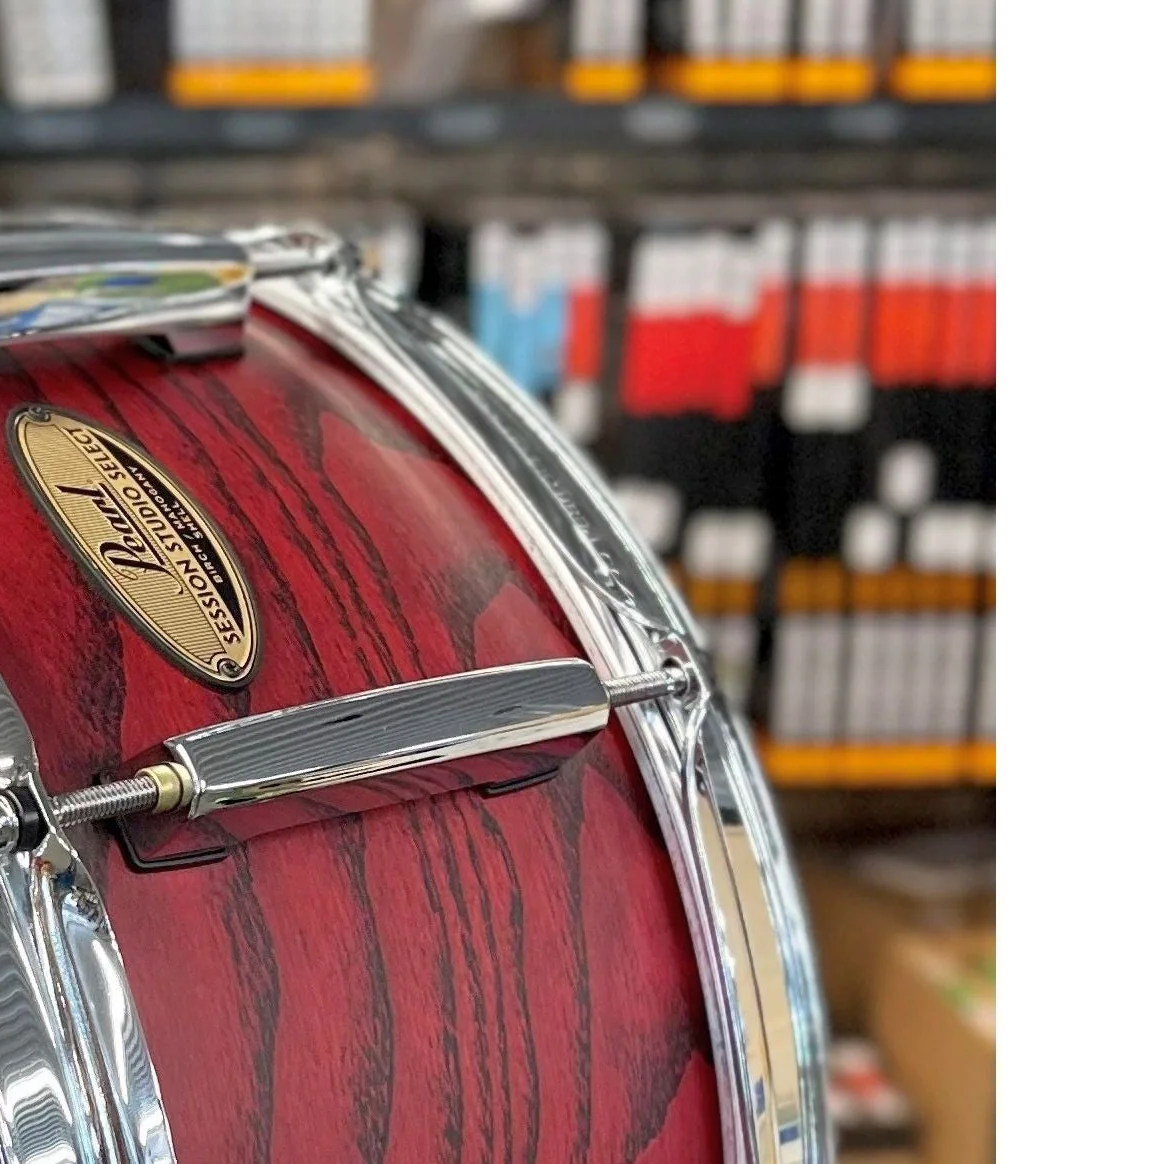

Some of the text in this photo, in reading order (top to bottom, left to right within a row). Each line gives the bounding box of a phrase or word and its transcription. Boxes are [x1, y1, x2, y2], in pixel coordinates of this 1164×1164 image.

[127, 465, 185, 531] MAHOGANY
[172, 499, 203, 539] SHELL
[55, 482, 184, 596] Pearl
[66, 426, 242, 646] SESSION STUDIO SELECT
[192, 544, 223, 584] BIRCH
